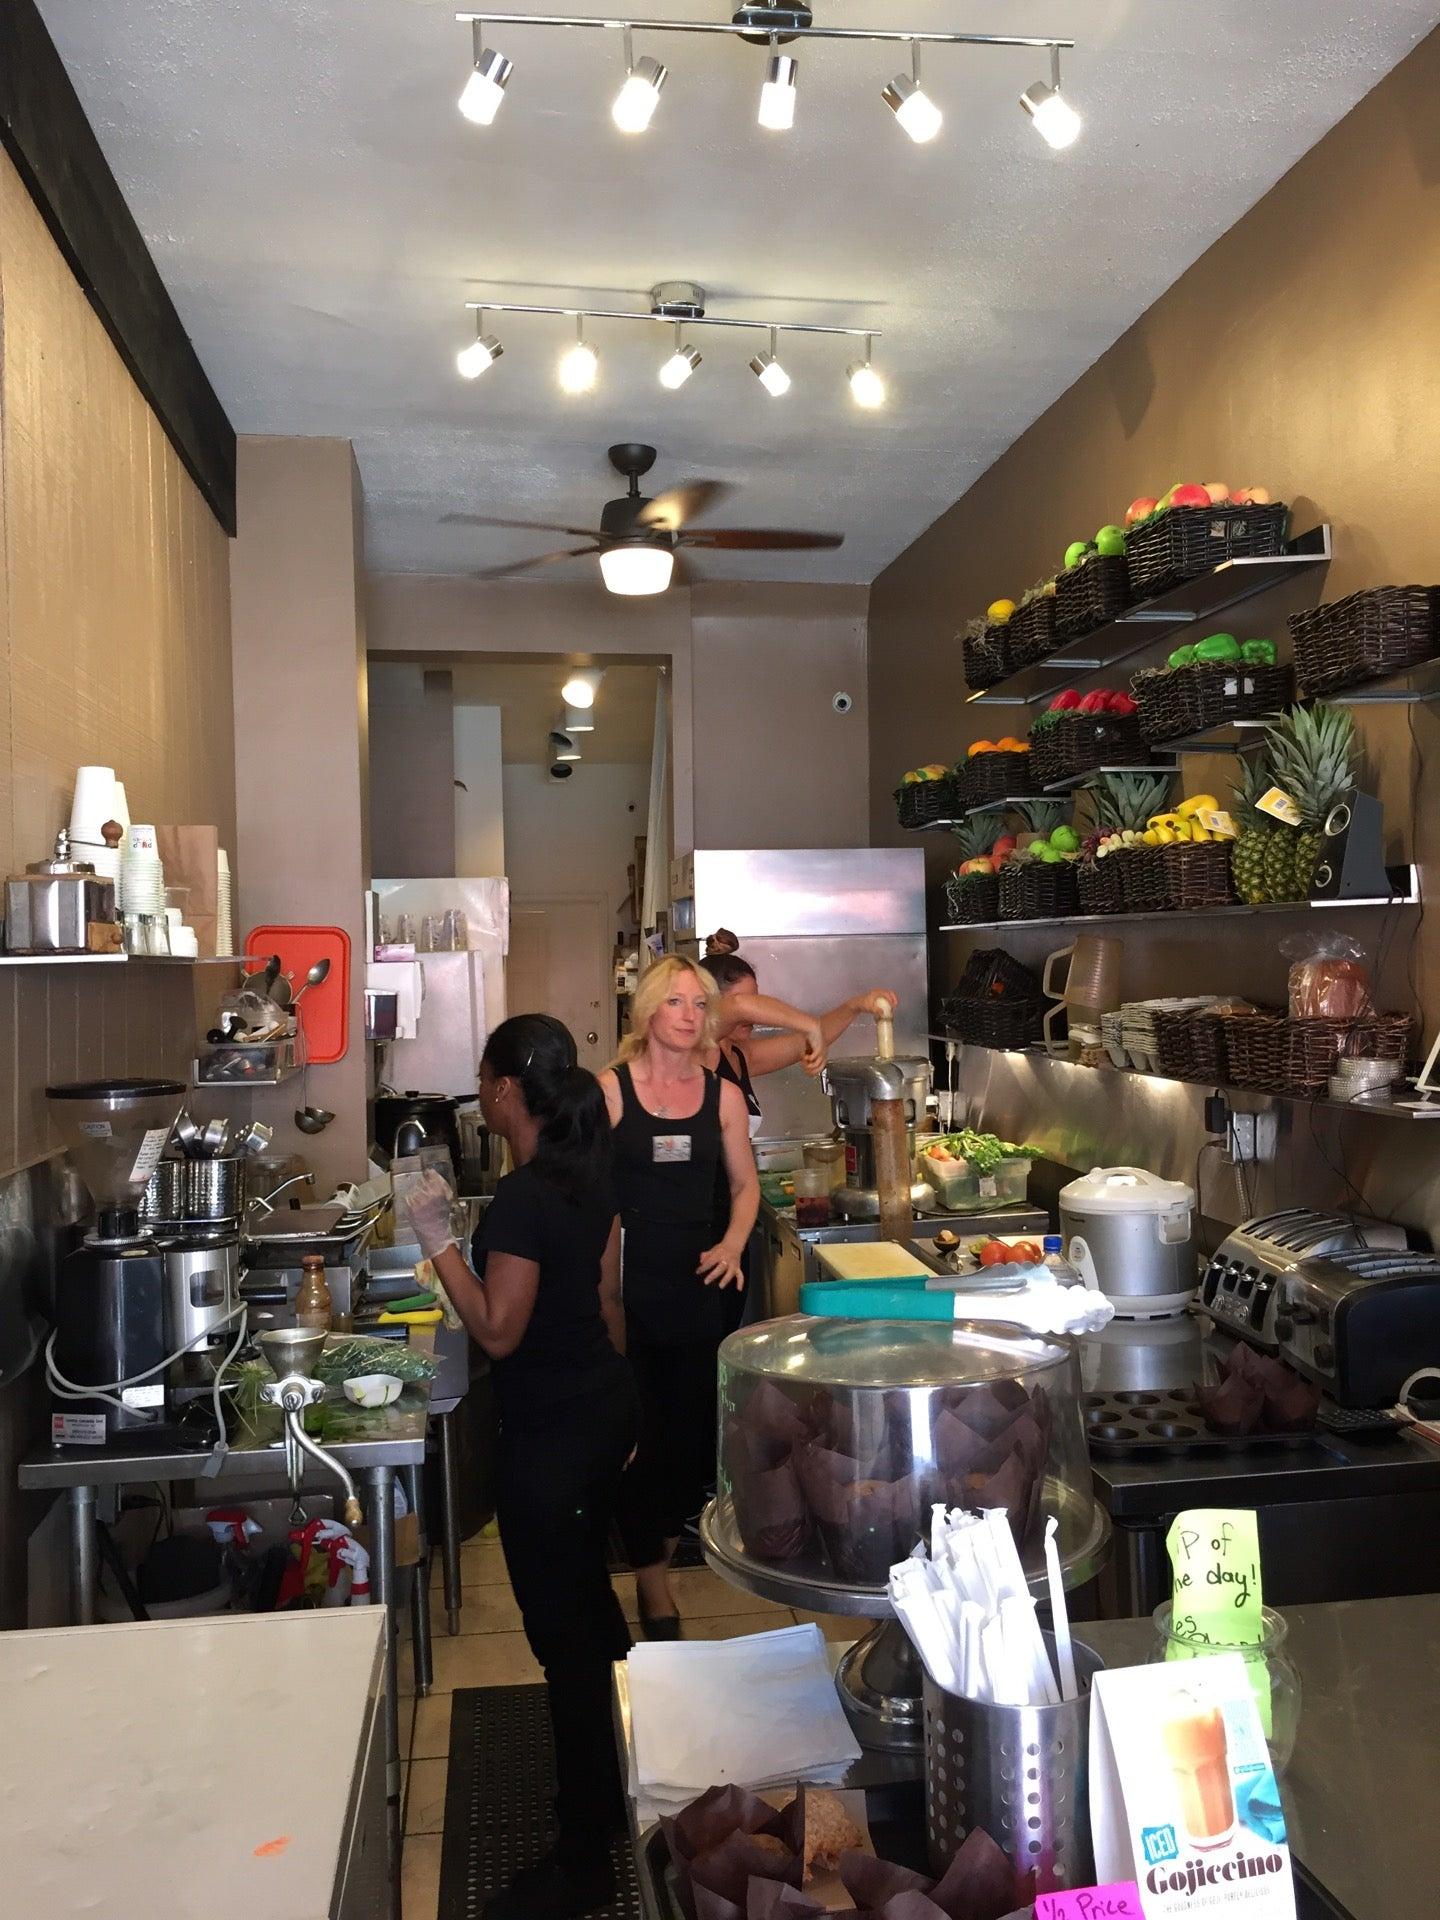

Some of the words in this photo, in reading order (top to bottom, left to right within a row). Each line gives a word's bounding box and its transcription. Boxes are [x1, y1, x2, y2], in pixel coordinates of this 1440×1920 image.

[1211, 1522, 1234, 1556] of
[1206, 1562, 1257, 1608] day!
[1145, 1828, 1176, 1861] ICED
[1146, 1851, 1283, 1897] Gojiccino
[1076, 1892, 1135, 1920] Price
